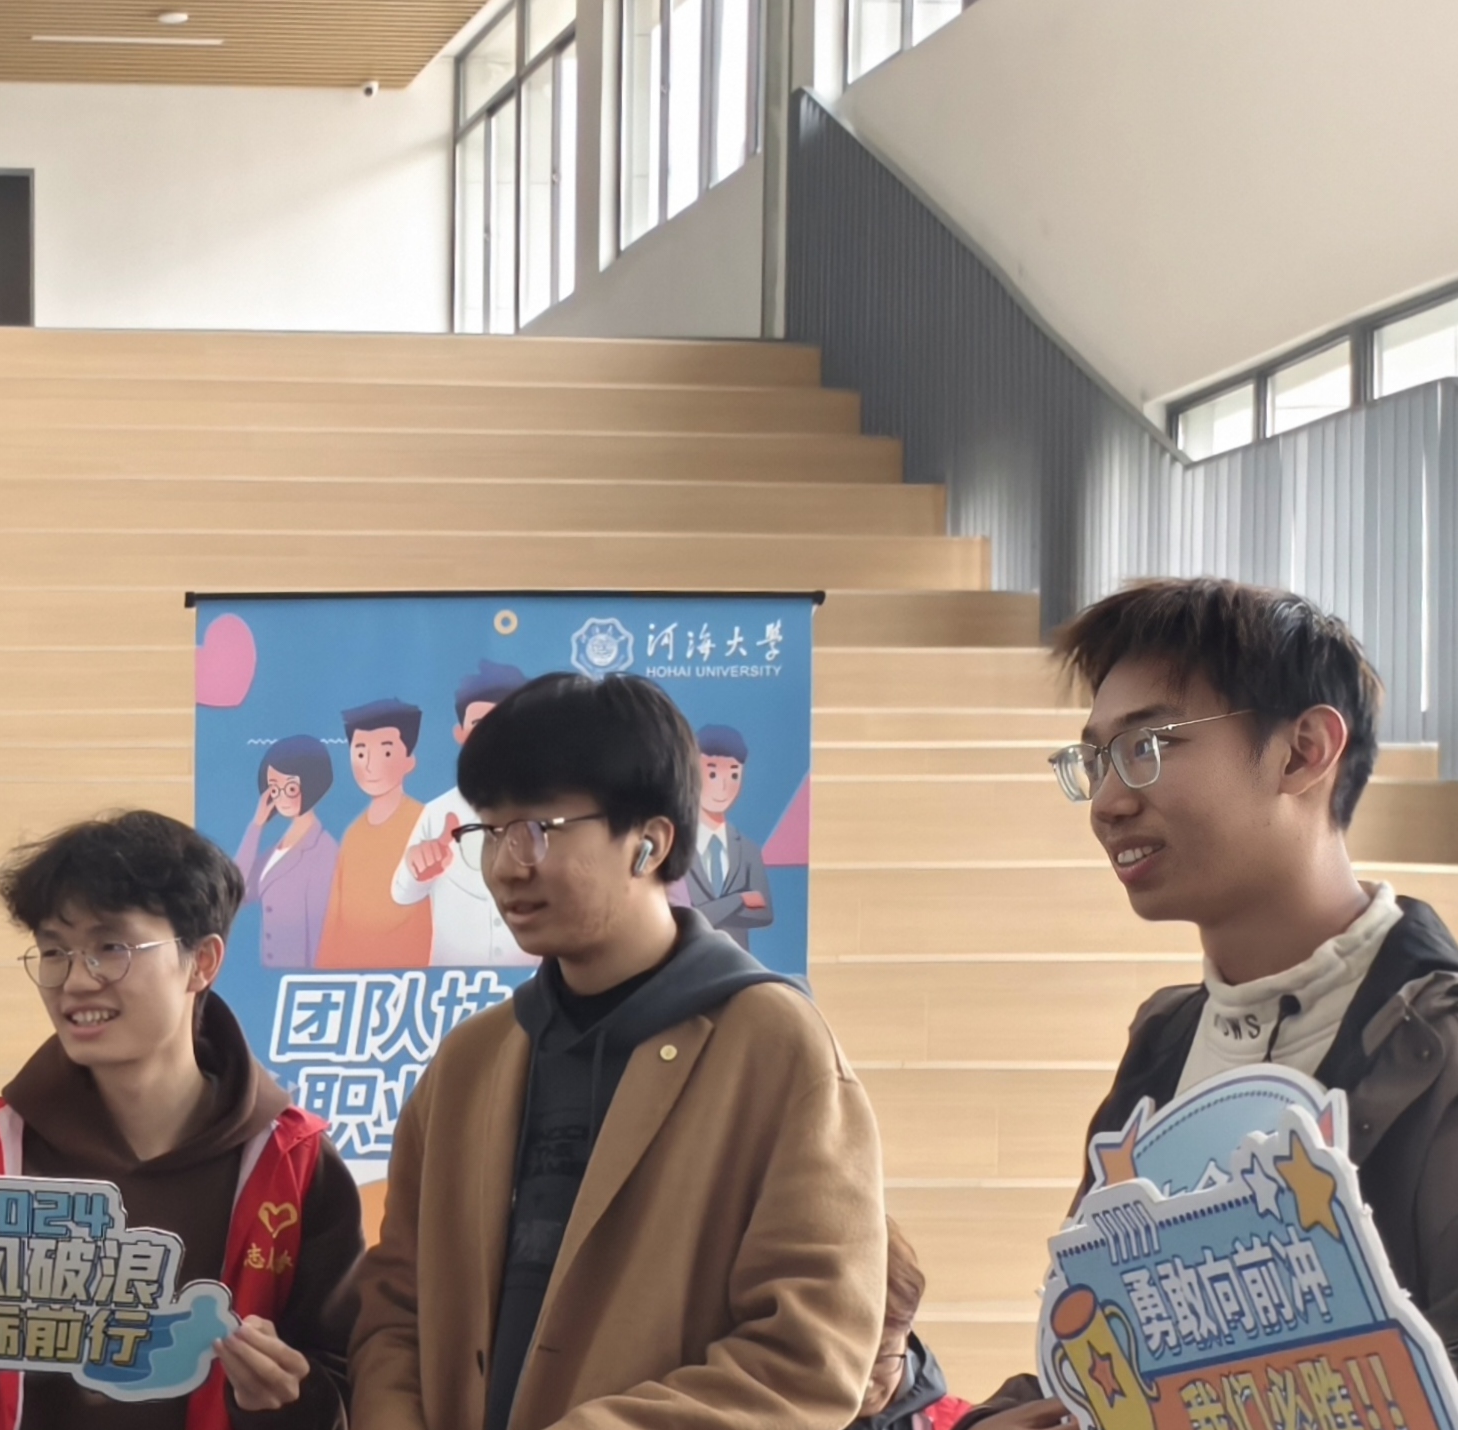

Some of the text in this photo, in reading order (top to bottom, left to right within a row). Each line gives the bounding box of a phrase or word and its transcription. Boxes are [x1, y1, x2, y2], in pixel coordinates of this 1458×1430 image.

[647, 666, 782, 677] HOHAI UNIVERSITY
[1122, 1226, 1333, 1358] 勇敢向前冲
